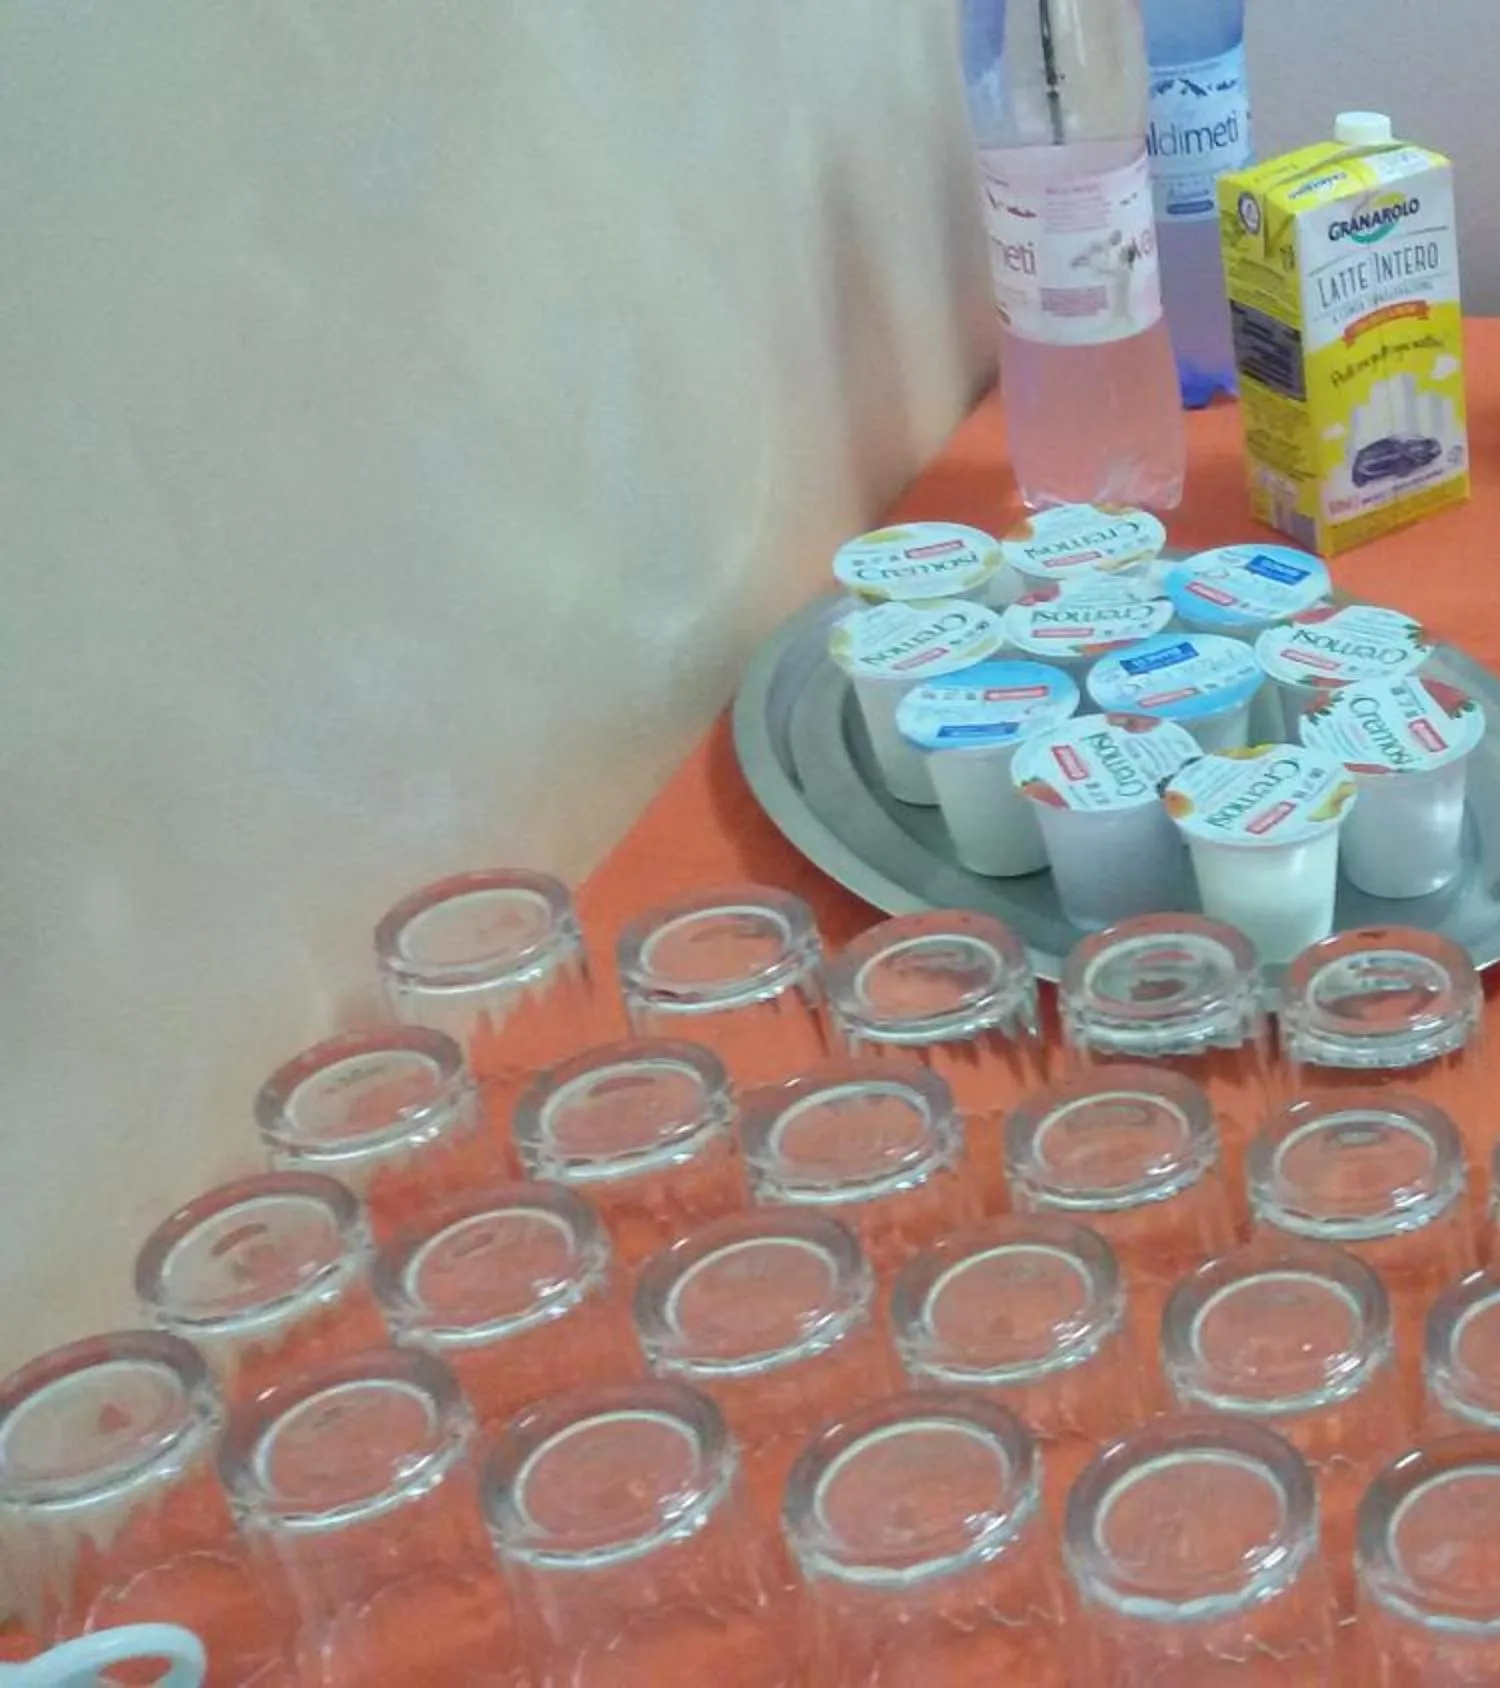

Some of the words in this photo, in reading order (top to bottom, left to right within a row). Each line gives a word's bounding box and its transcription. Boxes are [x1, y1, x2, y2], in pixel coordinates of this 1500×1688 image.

[1146, 110, 1239, 156] ldimeti
[1328, 198, 1420, 241] GRANAROLO
[1318, 262, 1369, 309] LATTE
[1374, 242, 1439, 284] INTERO
